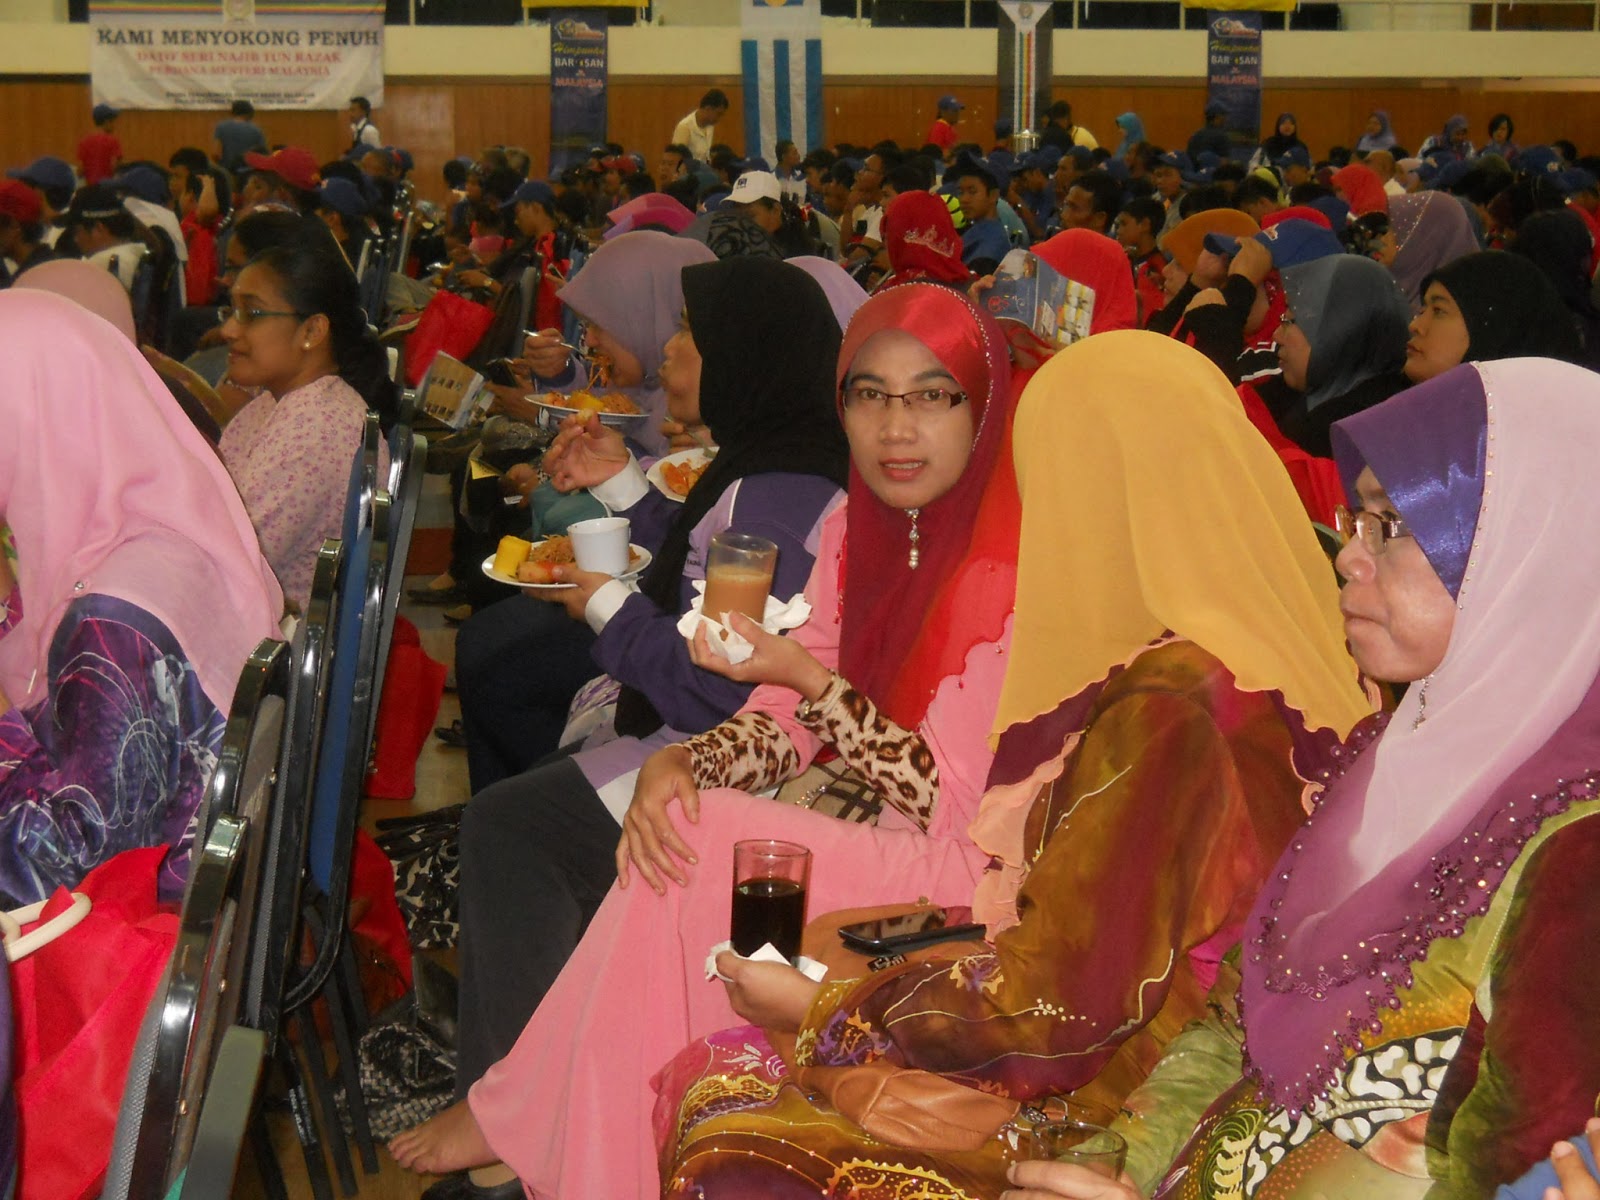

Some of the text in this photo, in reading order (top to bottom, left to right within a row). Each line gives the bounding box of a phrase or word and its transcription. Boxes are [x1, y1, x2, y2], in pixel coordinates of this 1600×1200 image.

[97, 29, 379, 46] KAMI MENYOKONG PENUH
